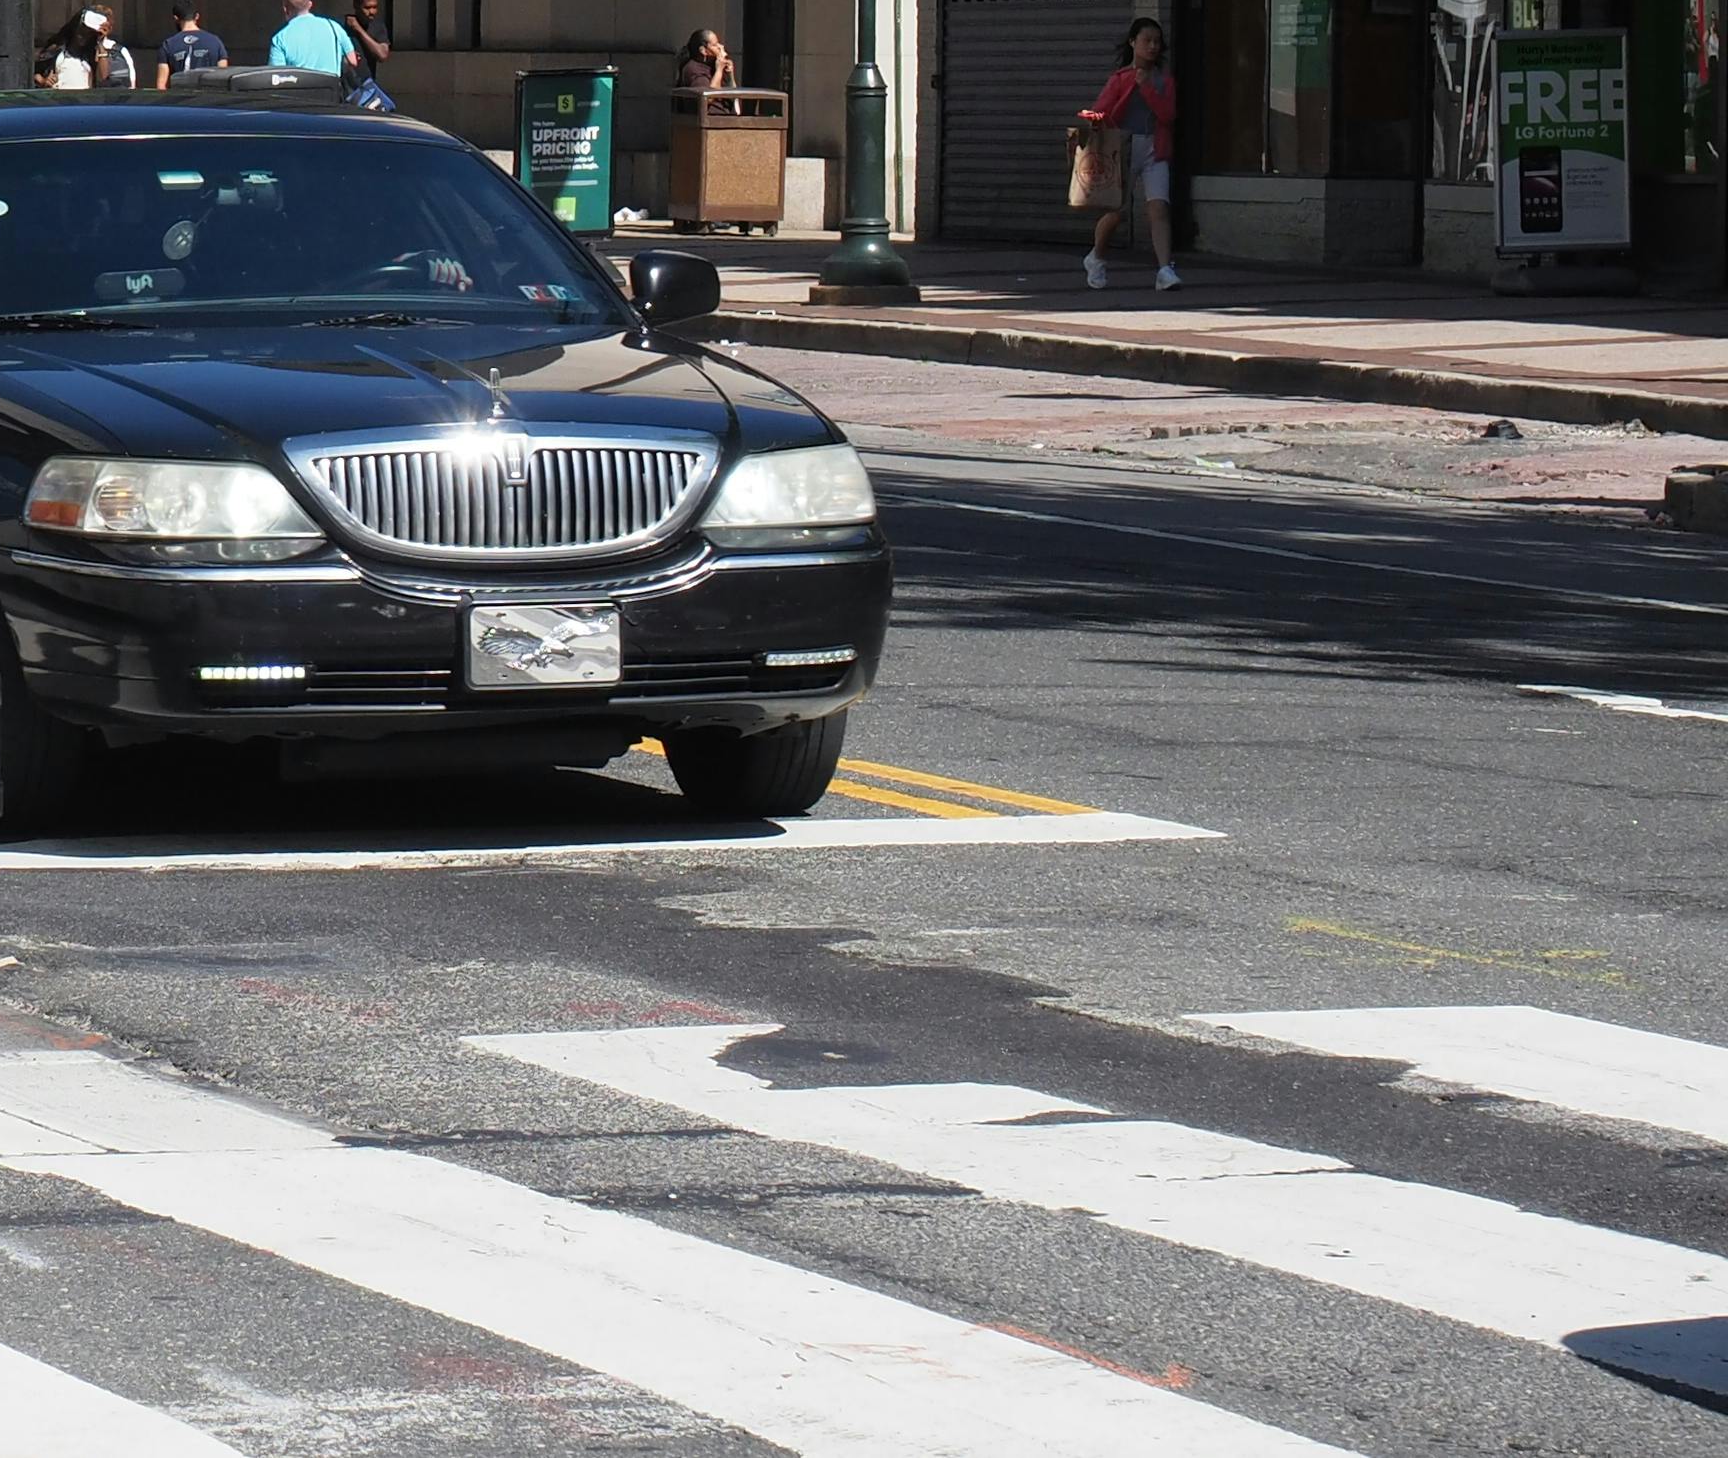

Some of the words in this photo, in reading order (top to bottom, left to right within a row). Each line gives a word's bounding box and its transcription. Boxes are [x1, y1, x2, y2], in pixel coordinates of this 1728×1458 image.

[1500, 69, 1625, 125] FREE
[532, 126, 600, 142] UPFRONT
[1515, 126, 1535, 140] LG
[1538, 125, 1596, 139] Fortune
[1599, 124, 1609, 137] 2
[532, 141, 591, 156] PRICING
[125, 274, 153, 294] lyft
